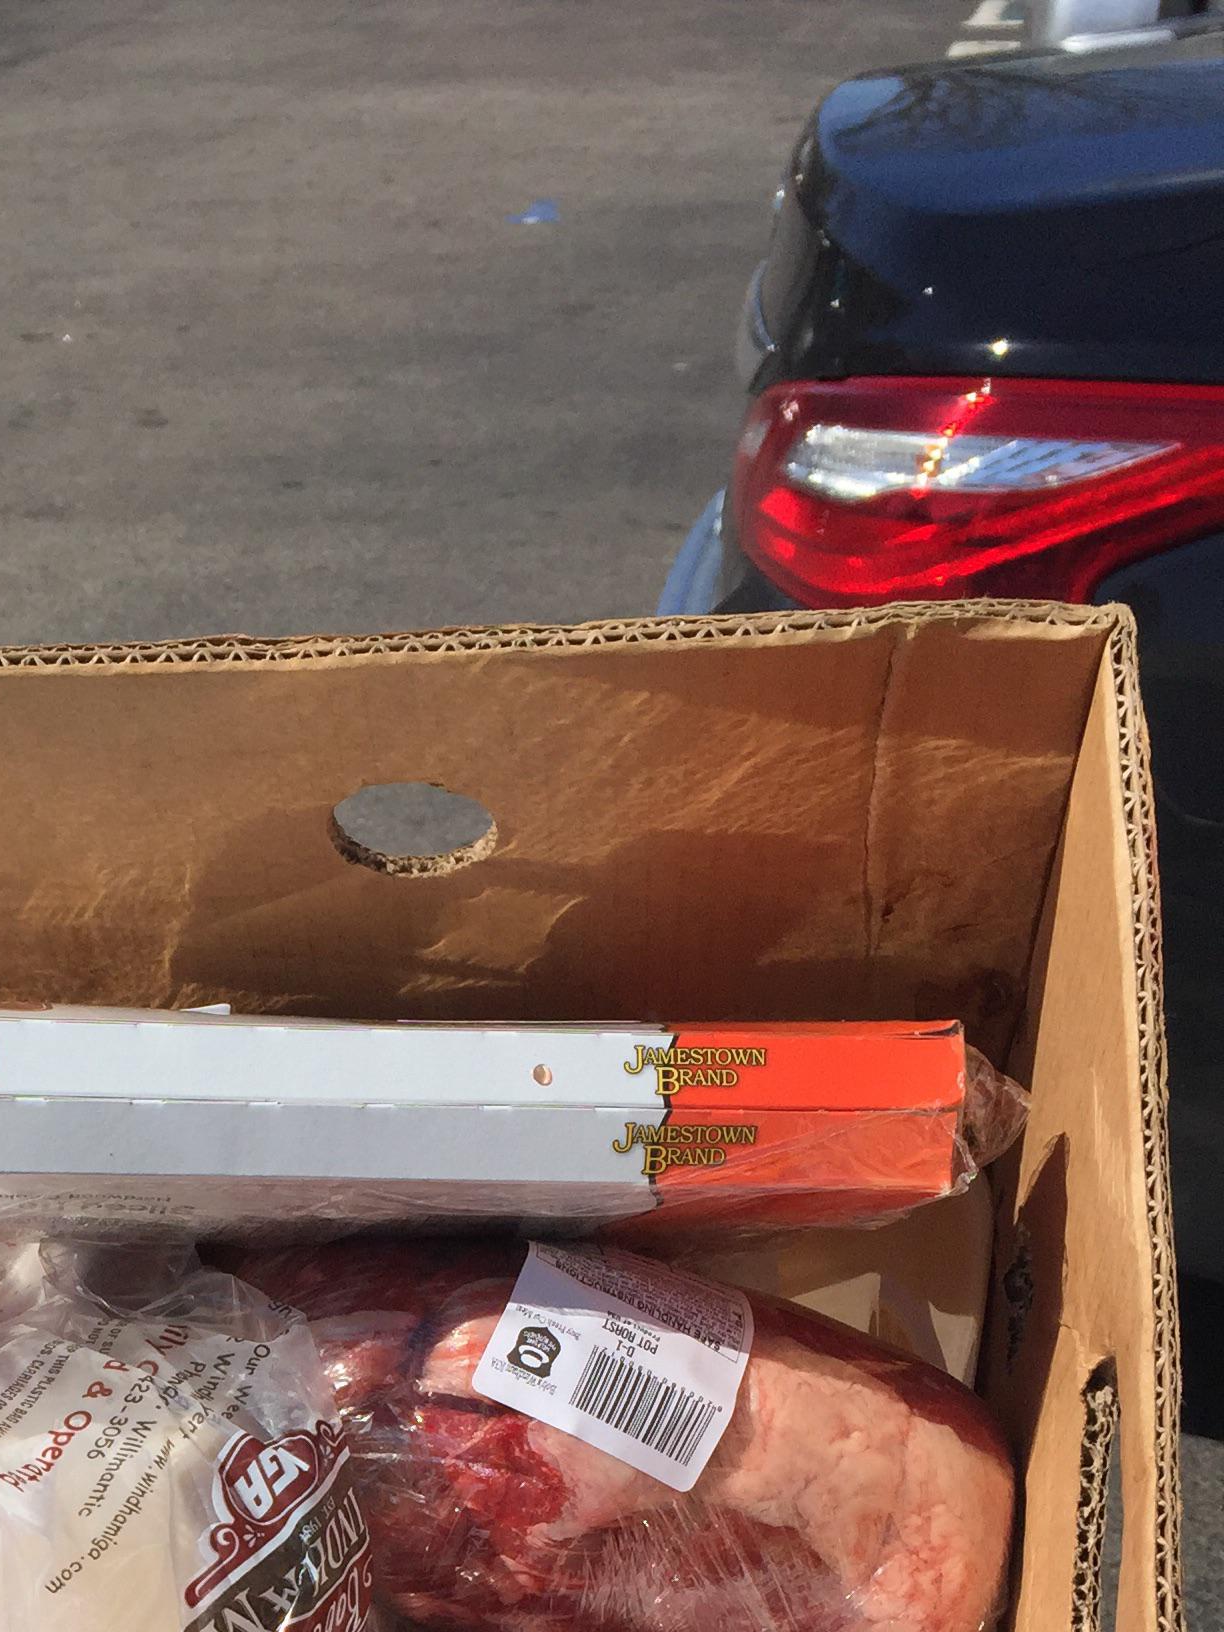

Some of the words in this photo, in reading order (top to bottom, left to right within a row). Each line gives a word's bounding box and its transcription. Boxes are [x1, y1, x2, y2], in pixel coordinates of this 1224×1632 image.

[624, 1044, 768, 1074] JAMESTOWN
[655, 1066, 738, 1095] BRAND
[612, 1123, 758, 1153] JAMESTOWN
[642, 1145, 726, 1175] BRAND
[602, 1318, 636, 1343] ROAST
[636, 1336, 659, 1355] POT
[82, 1381, 113, 1399] &
[78, 1420, 158, 1517] Willimantic
[234, 1447, 310, 1520] IGA
